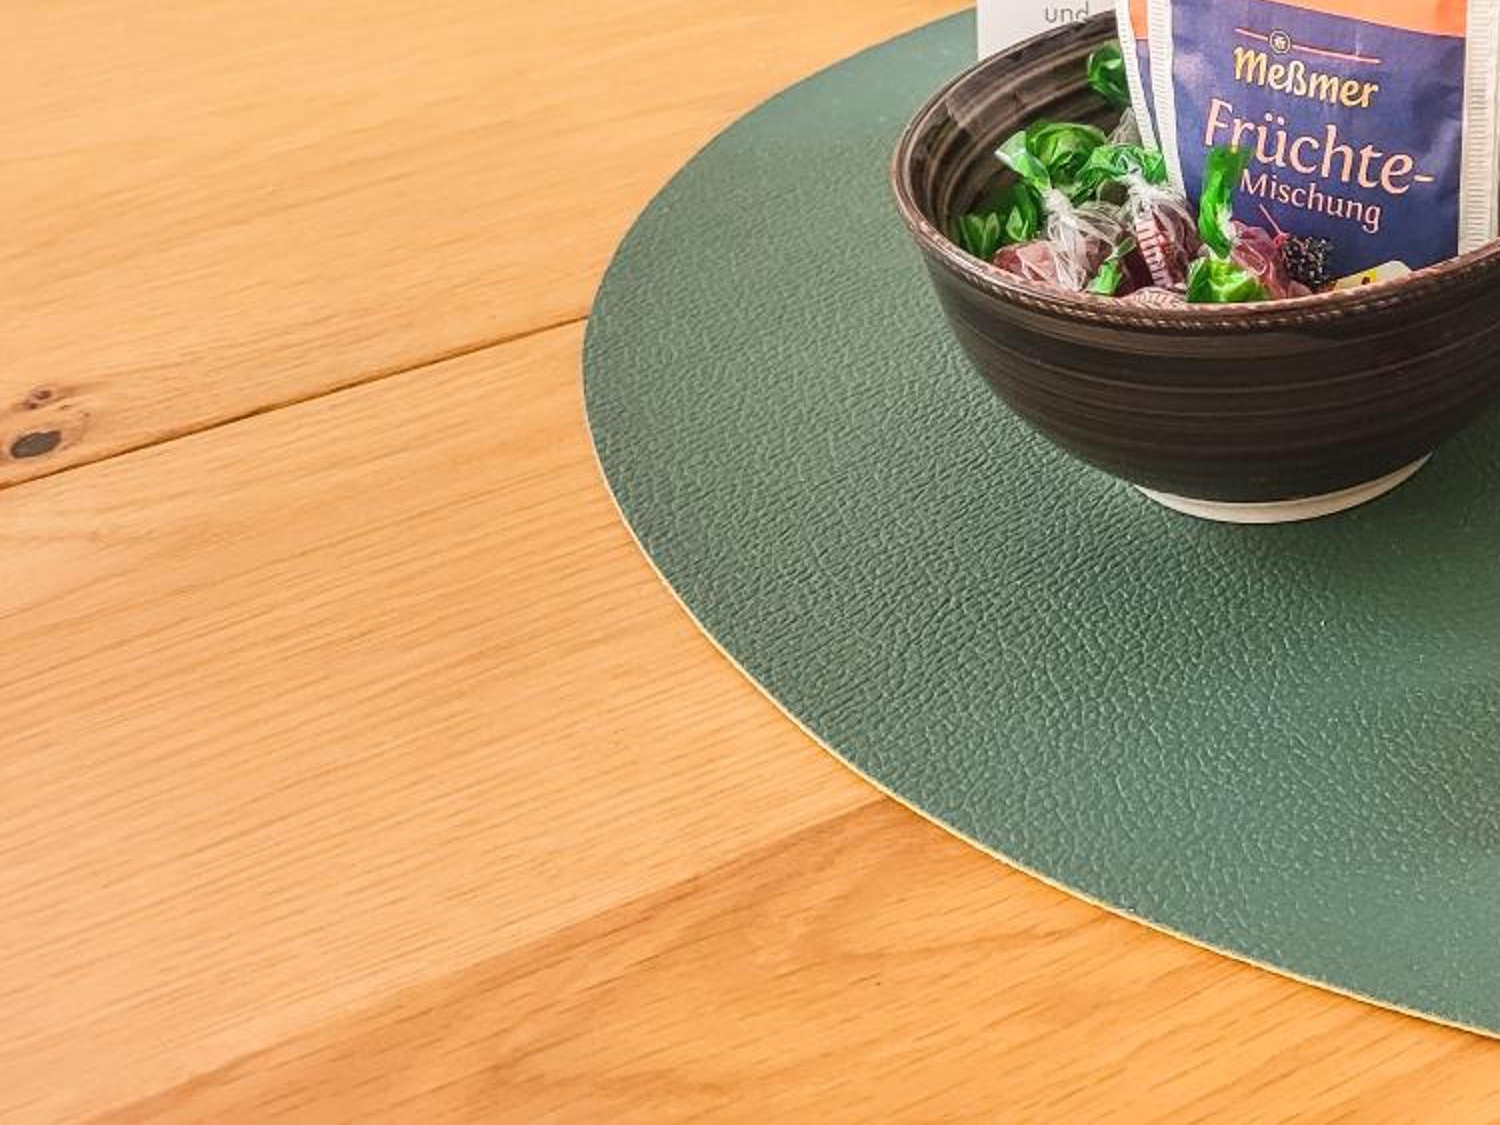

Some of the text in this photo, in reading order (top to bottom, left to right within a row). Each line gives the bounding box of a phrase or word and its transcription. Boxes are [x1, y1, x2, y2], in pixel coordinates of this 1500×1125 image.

[1045, 0, 1089, 23] und
[1232, 45, 1379, 109] Meßmer
[1204, 97, 1436, 195] Früchte-
[1239, 168, 1382, 235] Mischung
